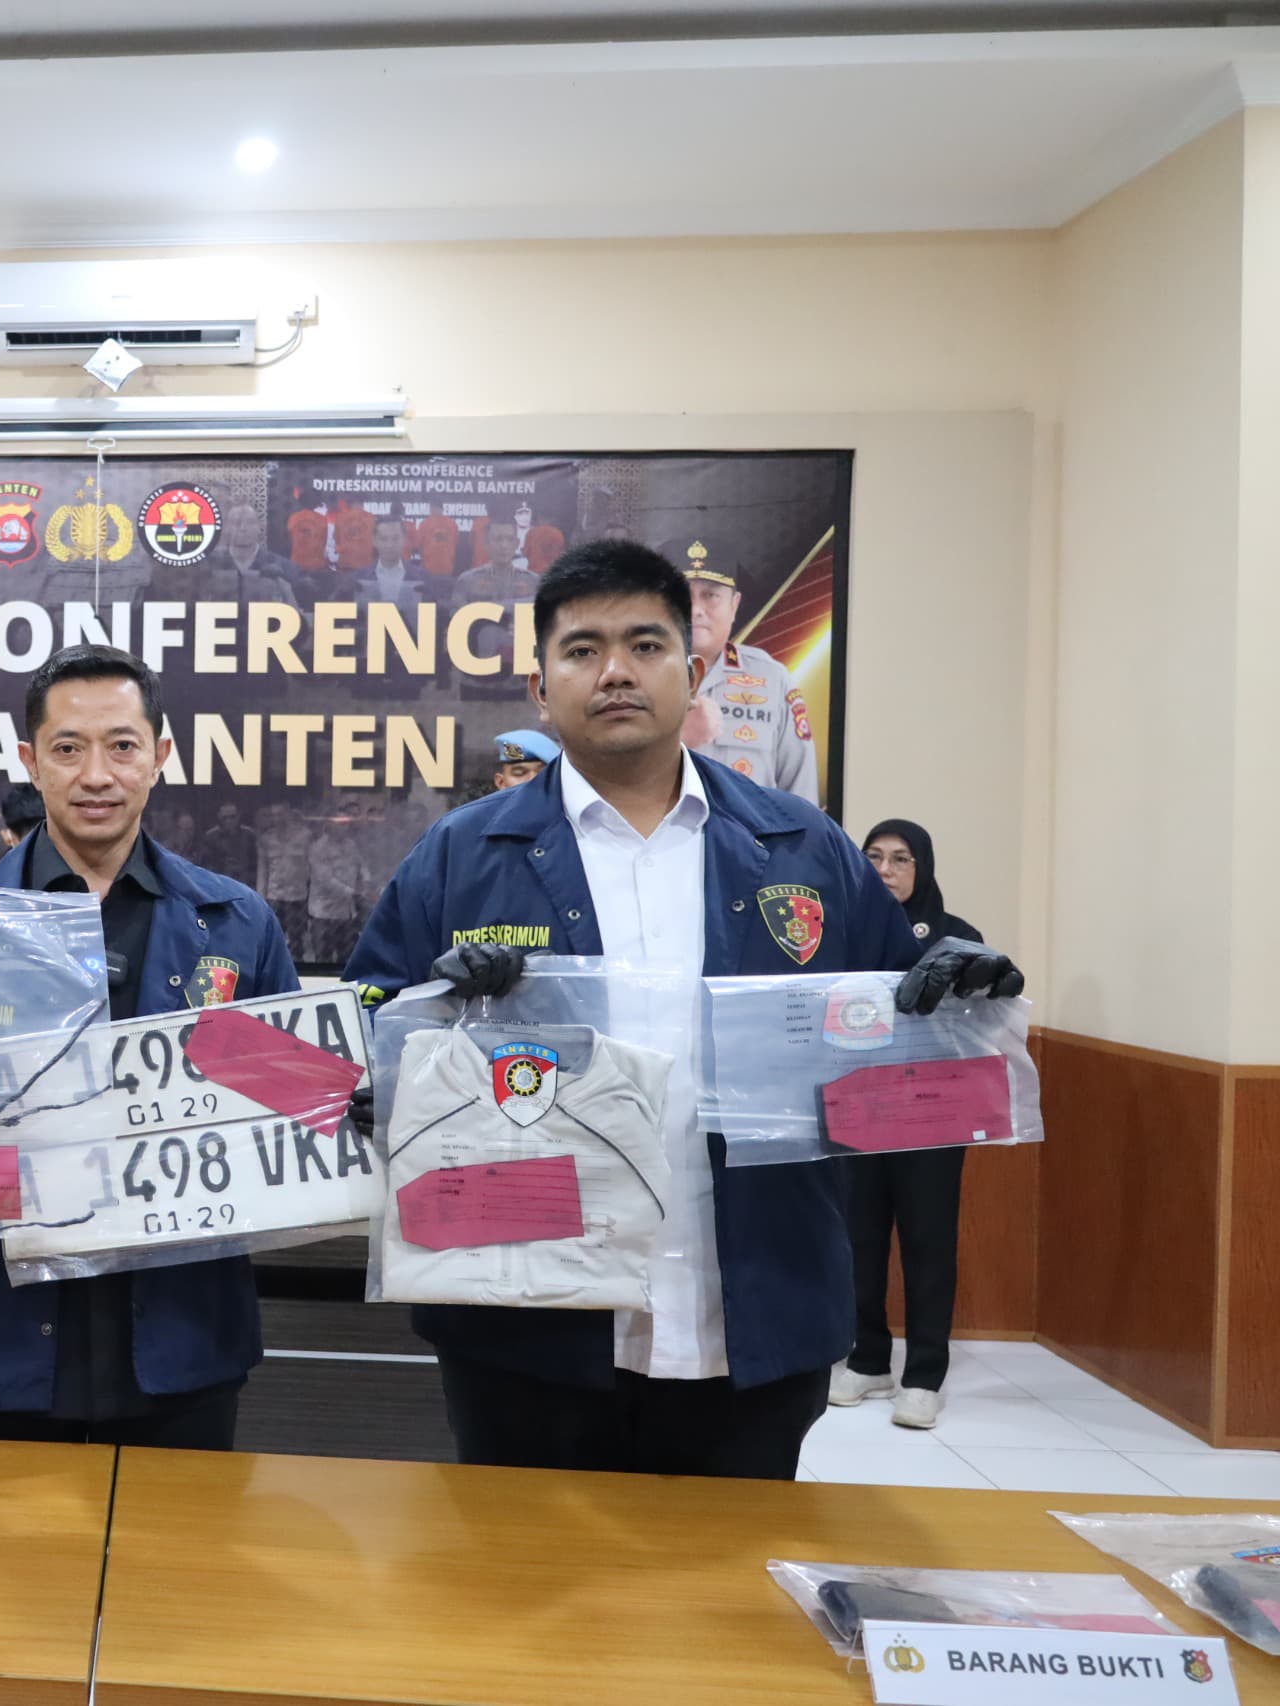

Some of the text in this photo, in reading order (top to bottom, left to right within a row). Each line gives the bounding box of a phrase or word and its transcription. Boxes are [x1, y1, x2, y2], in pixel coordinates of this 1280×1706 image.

[356, 464, 494, 477] PRESS CONFERENCE
[313, 479, 536, 493] DITRESKRIMUM POLDA BANTEN
[501, 1046, 548, 1057] INAFIS
[251, 1115, 372, 1186] VKA
[947, 1650, 1164, 1678] BARANG BUKTI
